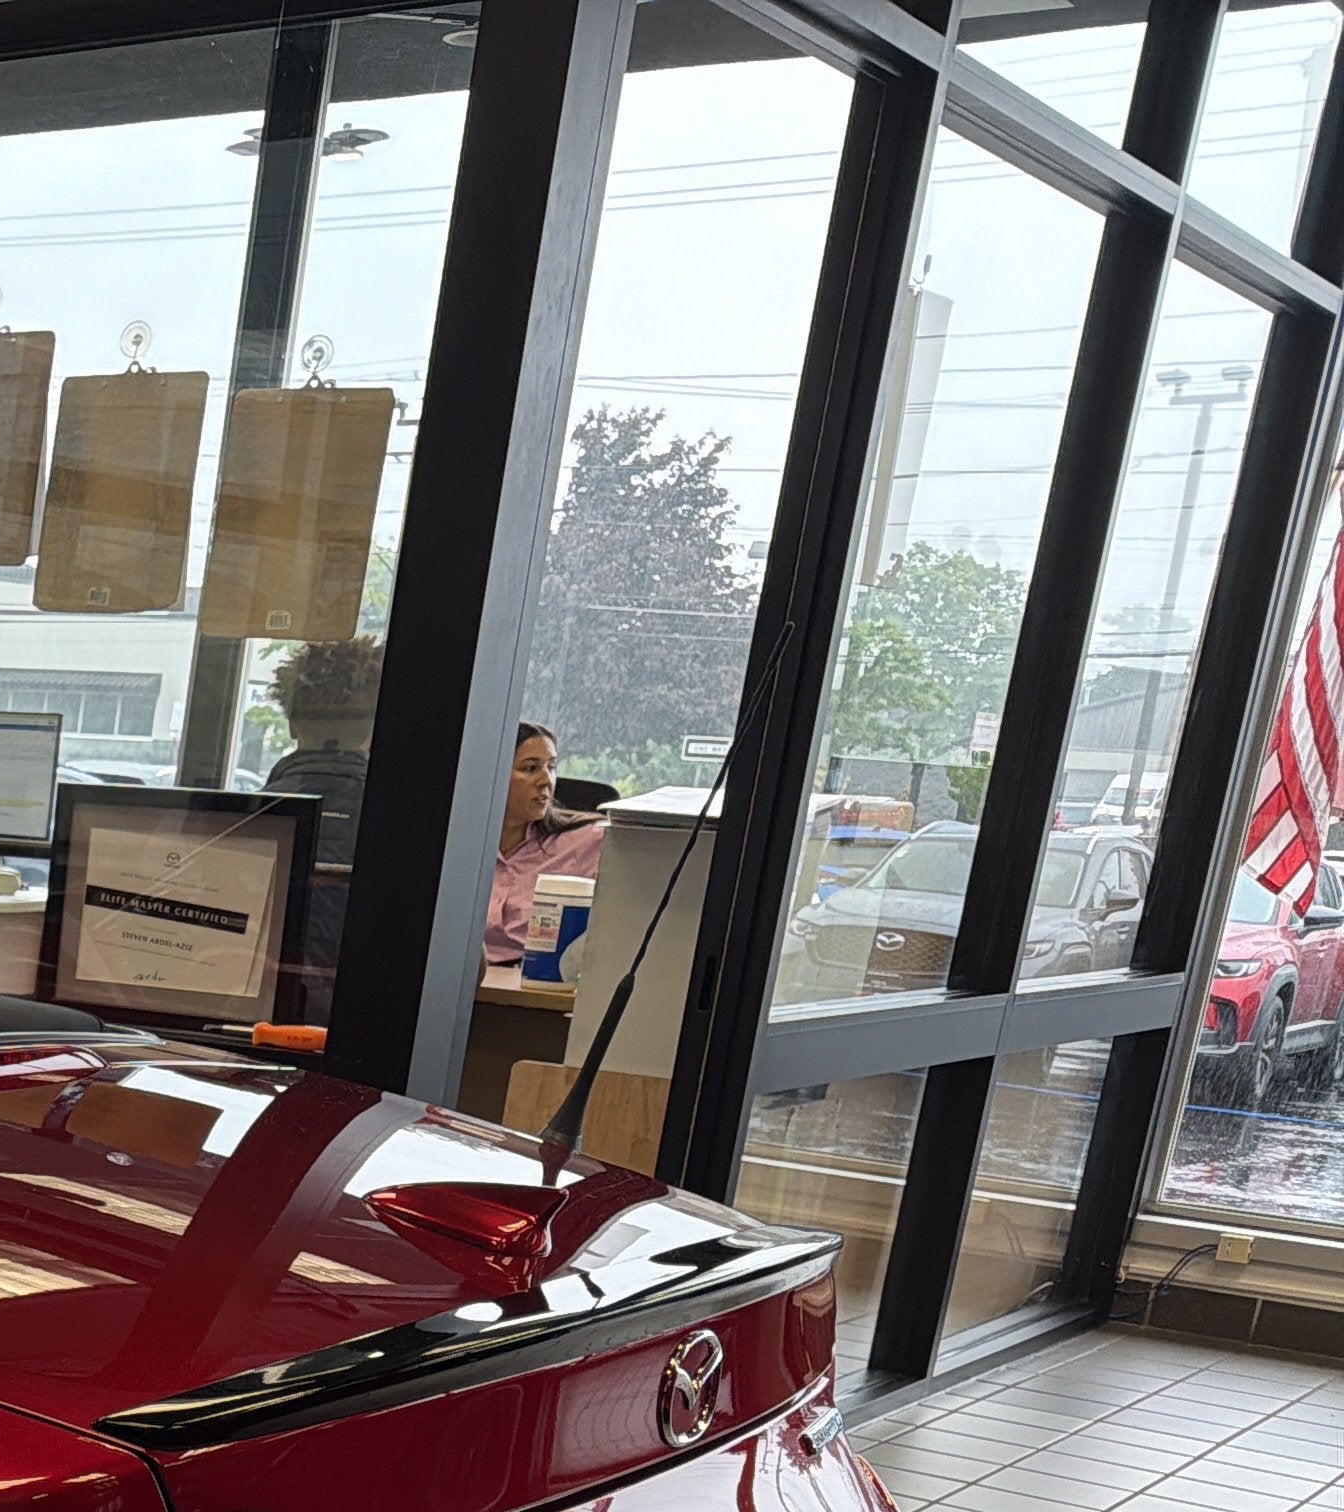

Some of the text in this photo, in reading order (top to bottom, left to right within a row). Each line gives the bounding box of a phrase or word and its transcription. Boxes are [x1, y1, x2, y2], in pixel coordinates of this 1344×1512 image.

[100, 892, 229, 925] ELITE MASTER CERTIFIED
[121, 930, 149, 944] STEVEN
